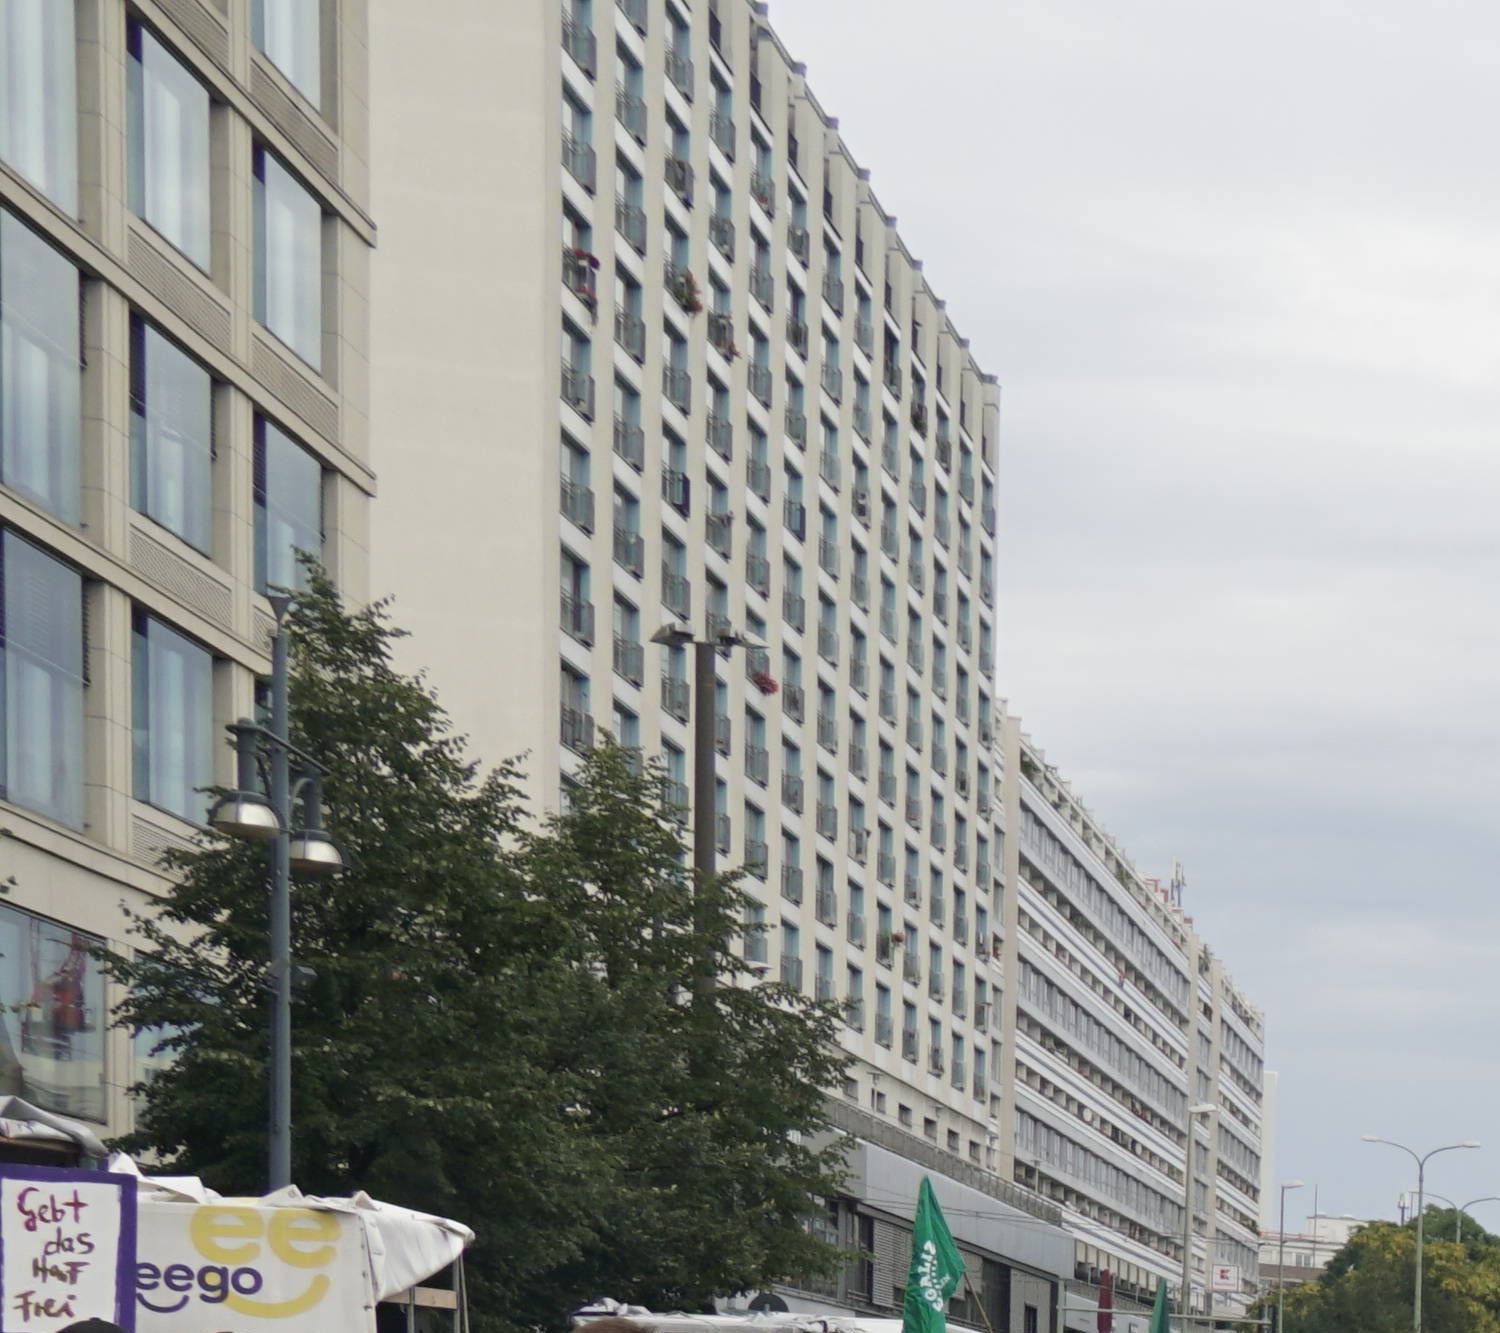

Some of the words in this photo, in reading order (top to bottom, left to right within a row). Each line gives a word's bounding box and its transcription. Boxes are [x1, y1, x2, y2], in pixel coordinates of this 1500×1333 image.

[17, 1187, 88, 1231] Gebt
[44, 1227, 95, 1255] das
[13, 1290, 77, 1322] Frei
